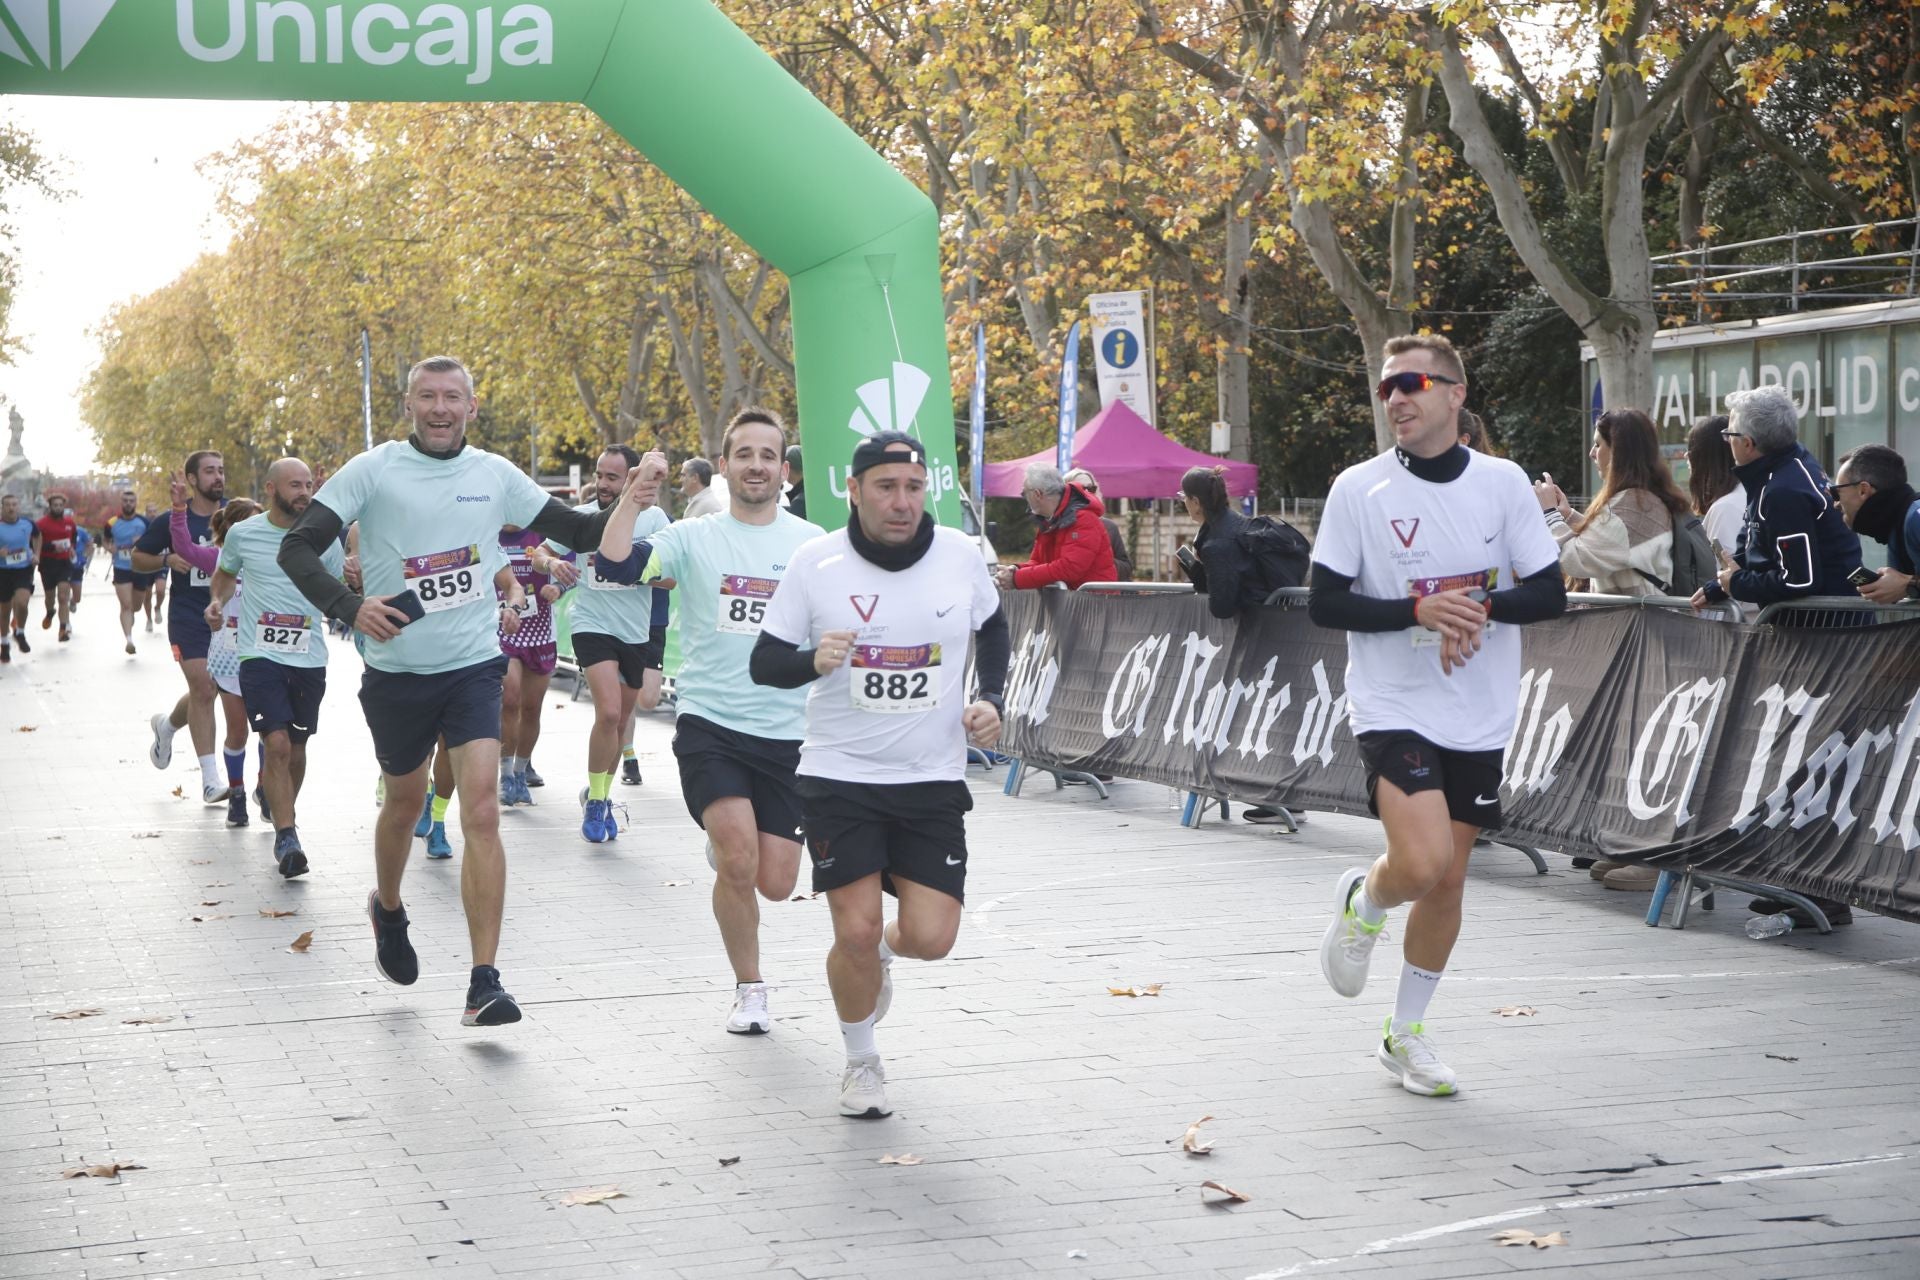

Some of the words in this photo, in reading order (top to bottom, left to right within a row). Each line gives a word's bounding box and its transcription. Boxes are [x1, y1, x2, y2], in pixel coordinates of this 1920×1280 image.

[176, 0, 553, 85] Unicaja
[829, 457, 954, 502] Uaja
[456, 494, 491, 503] OneHealth
[418, 570, 472, 602] 859
[729, 598, 767, 624] 85
[263, 627, 303, 646] 827
[864, 671, 928, 700] 882
[1102, 632, 1171, 739] El
[1163, 631, 1291, 762] Norte
[1627, 676, 1727, 828] El
